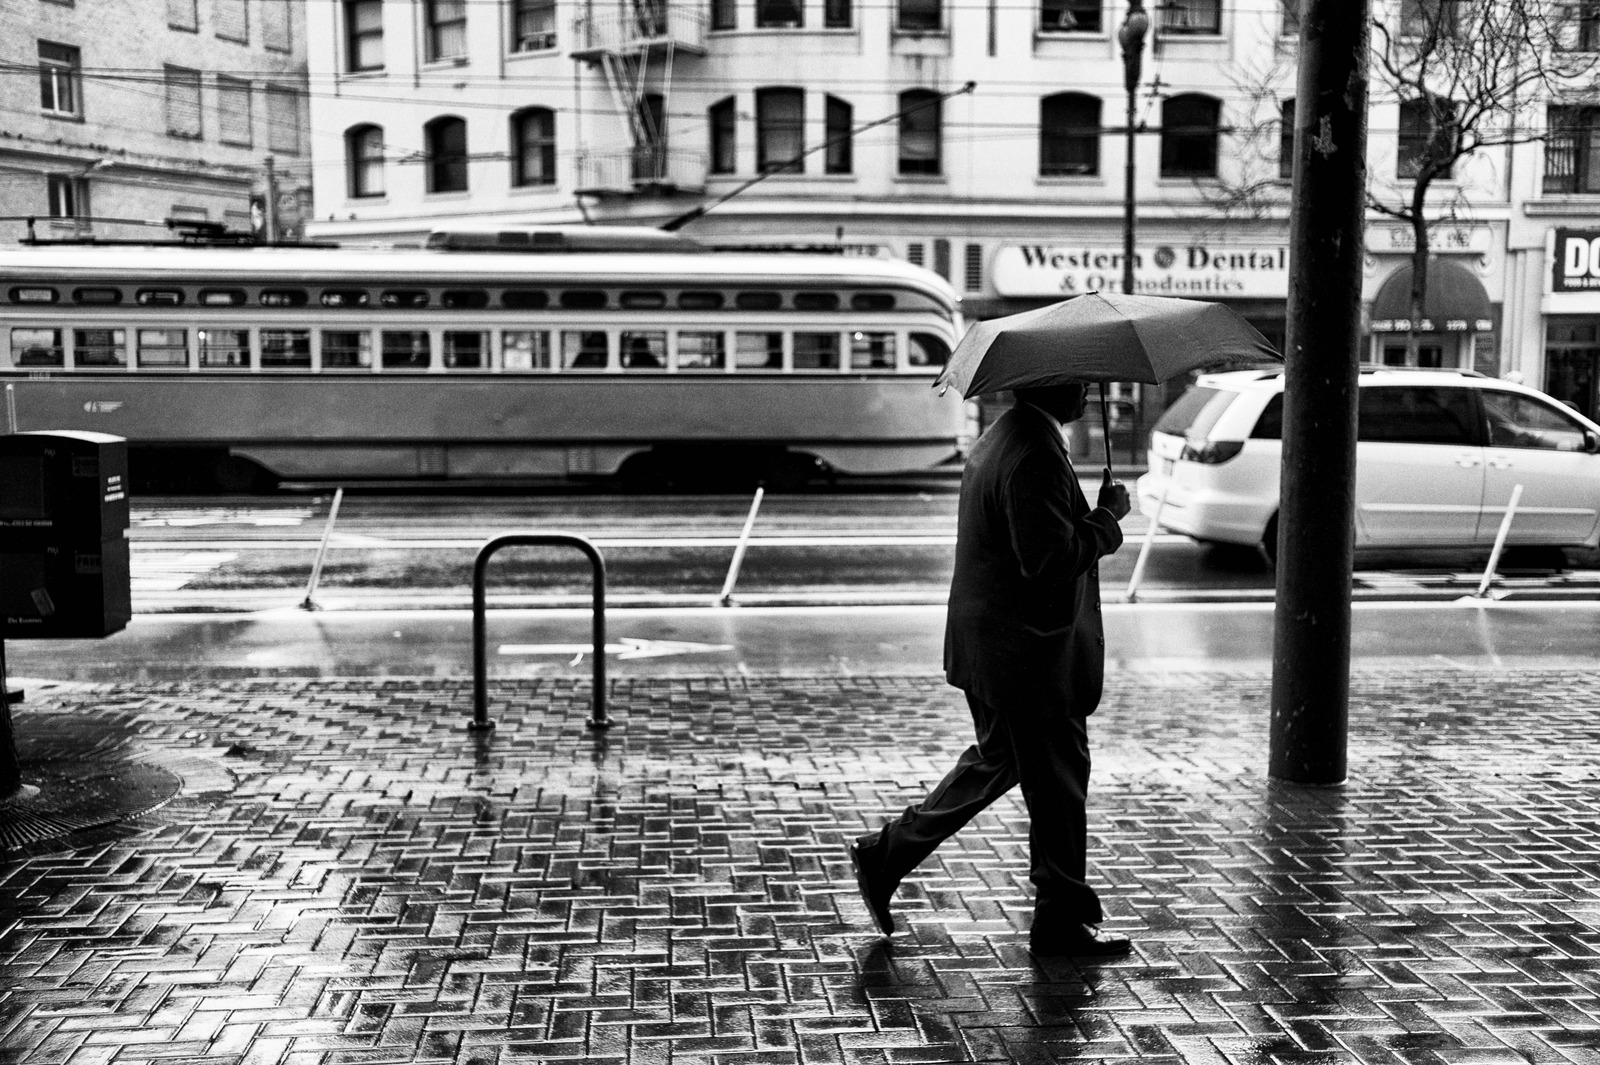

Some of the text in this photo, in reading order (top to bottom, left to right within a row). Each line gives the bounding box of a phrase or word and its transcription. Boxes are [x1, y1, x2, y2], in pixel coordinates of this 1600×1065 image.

[1187, 245, 1285, 270] Dental
[1059, 274, 1244, 292] & Orodontics
